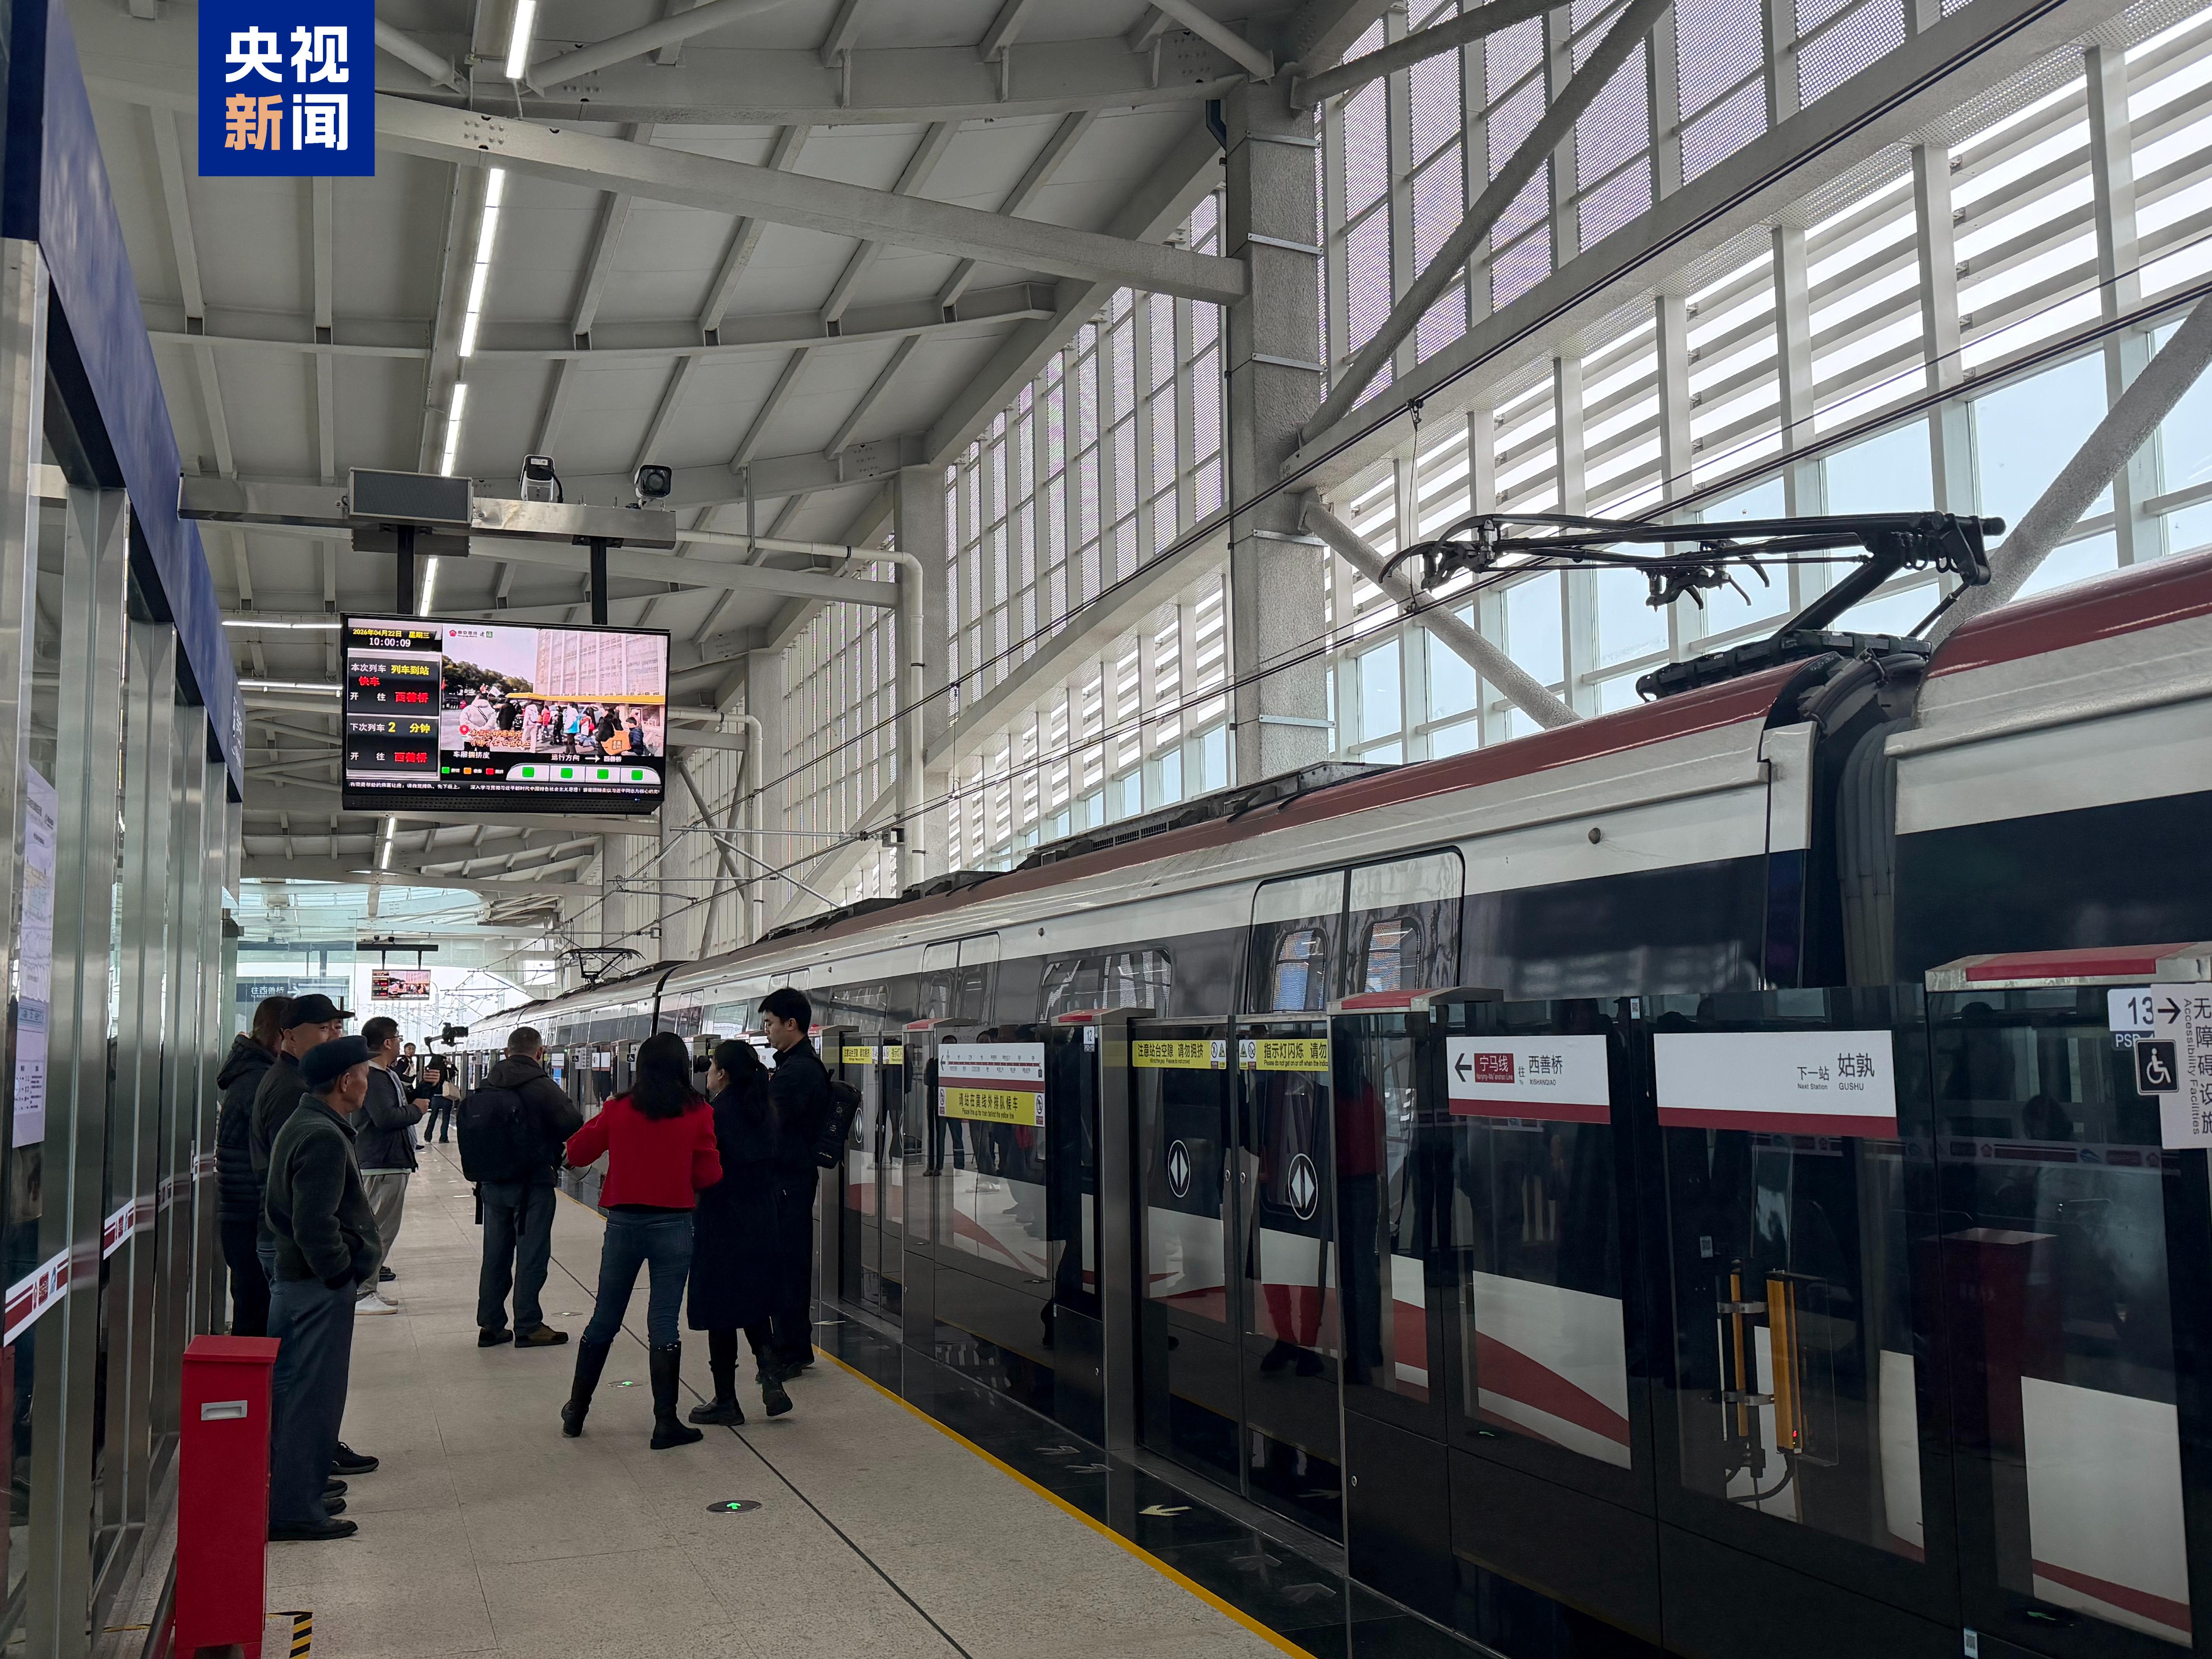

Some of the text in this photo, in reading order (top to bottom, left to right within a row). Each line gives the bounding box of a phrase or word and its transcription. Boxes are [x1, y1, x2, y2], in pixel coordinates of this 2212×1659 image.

[353, 629, 402, 637] 2026年04月22日
[369, 637, 411, 647] 10:00:09
[351, 663, 429, 675] 本次列车 列车到站
[359, 676, 380, 686] 快车
[350, 692, 359, 700] 开
[377, 693, 386, 701] 往
[350, 722, 431, 733] 下次列车 2 分钟
[350, 752, 359, 760] 开
[376, 752, 385, 761] 往
[2128, 996, 2154, 1025] 13
[1087, 1029, 1092, 1041] 12
[1138, 1043, 1203, 1058] 注意站台空隙 请勿拥挤
[1264, 1042, 1327, 1059] 指示灯闪烁 请勿
[1480, 1055, 1509, 1072] 宁马线
[1518, 1055, 1563, 1077] 往 西善桥
[1797, 1053, 1875, 1081] 下一站 姑孰
[2184, 998, 2200, 1135] Accessibility Facilities
[959, 1093, 1018, 1112] 请站在黄线外排队候车
